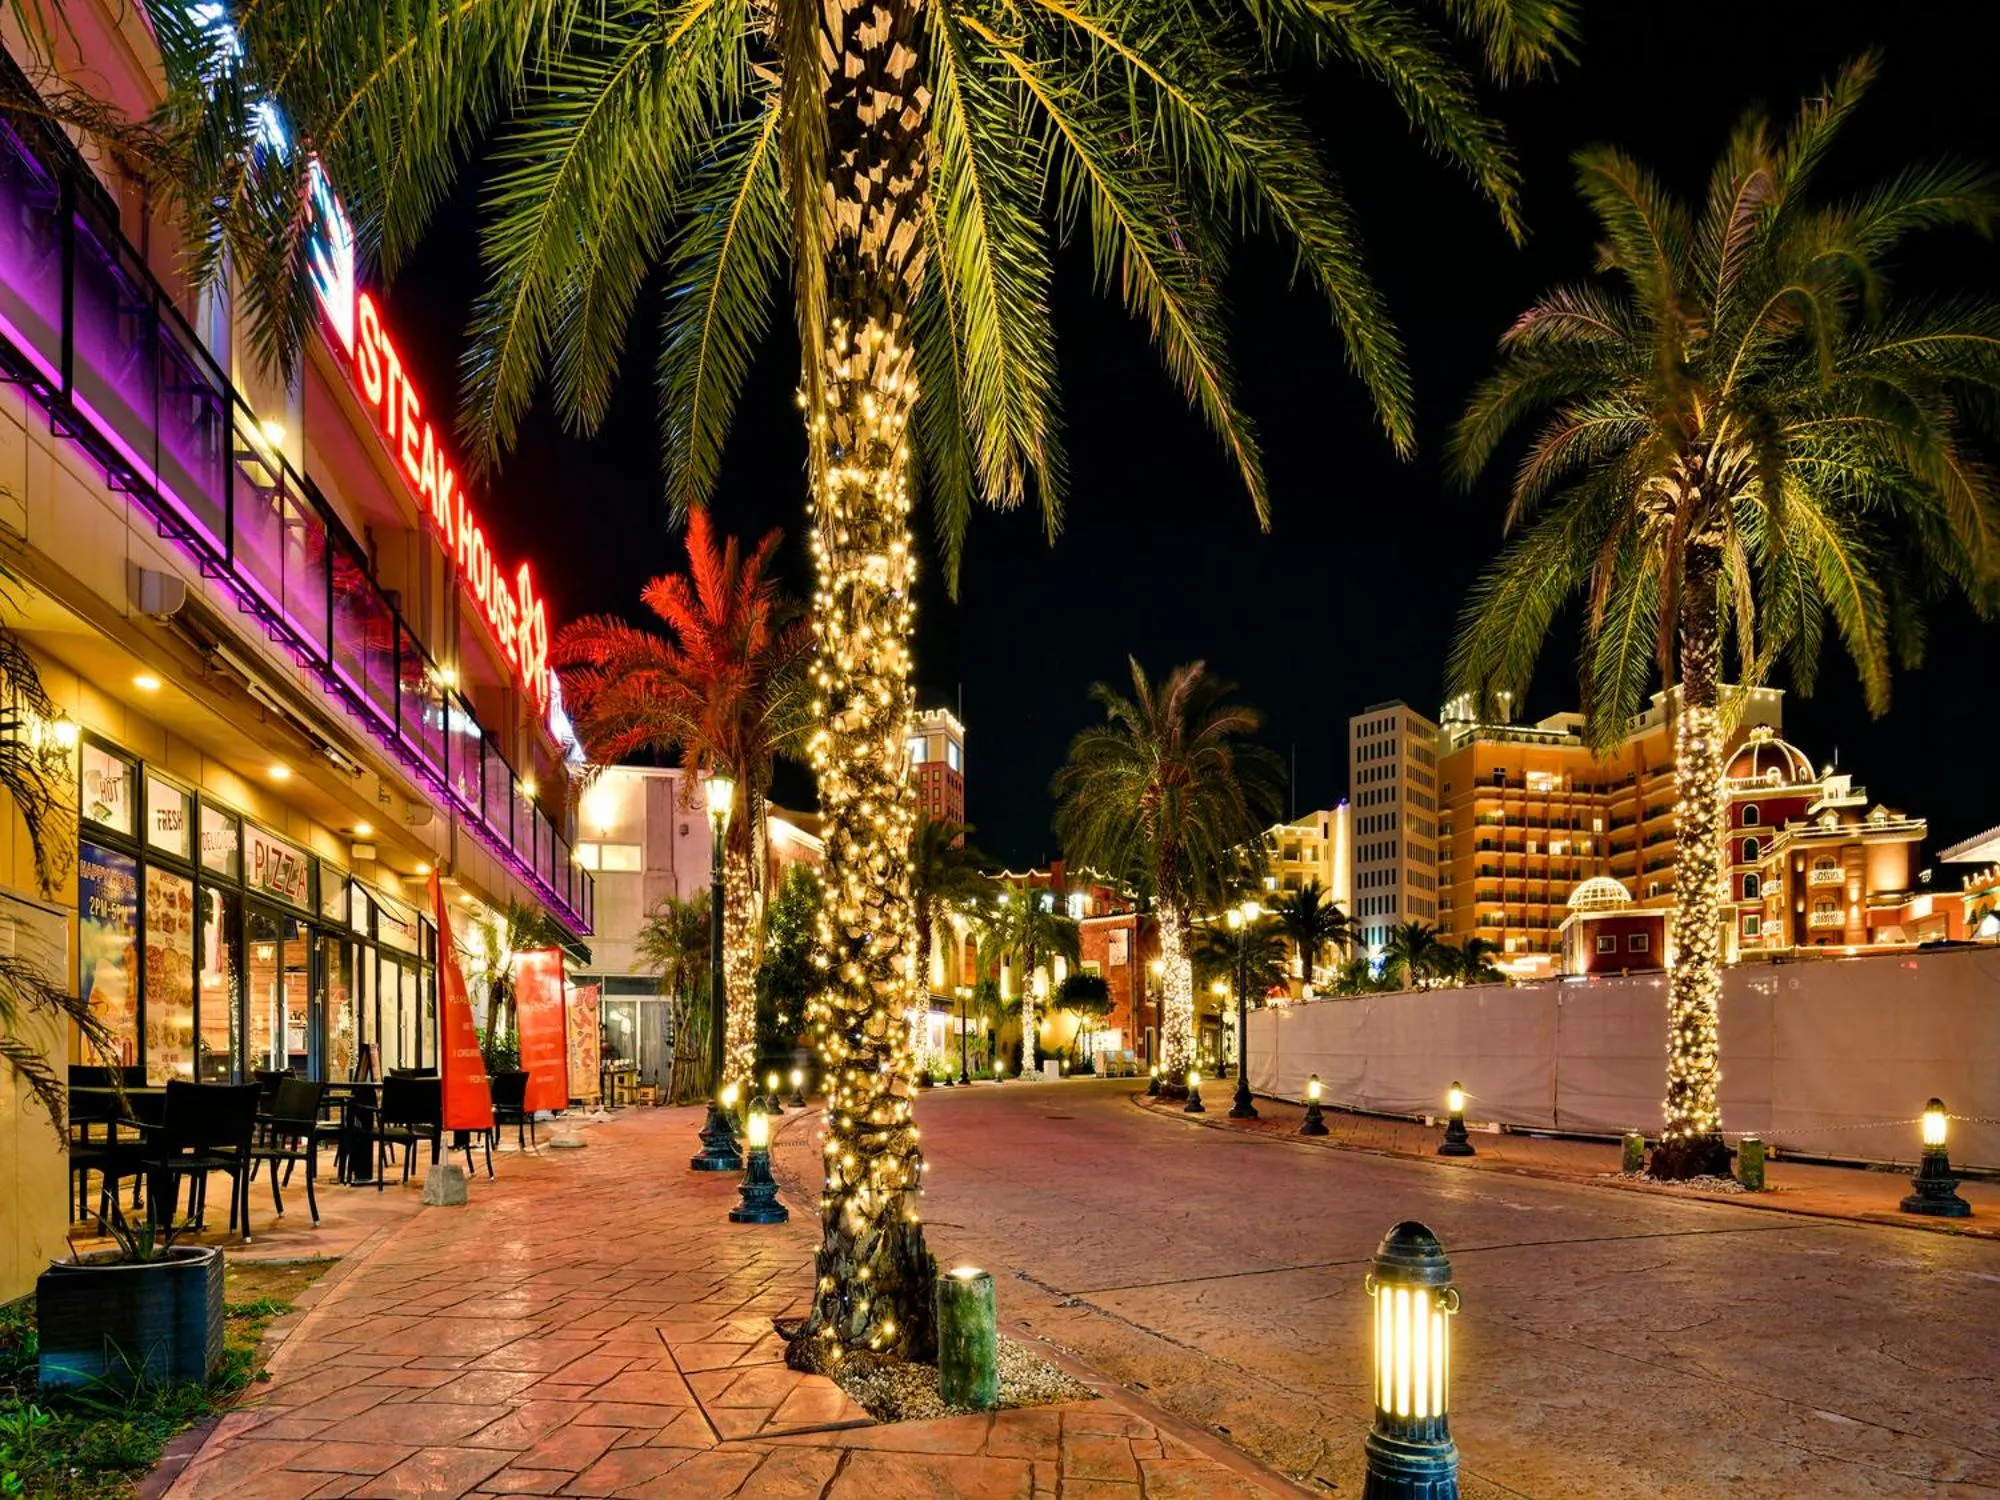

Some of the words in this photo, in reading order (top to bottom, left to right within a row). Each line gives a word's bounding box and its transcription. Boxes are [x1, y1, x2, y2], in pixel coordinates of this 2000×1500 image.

[357, 292, 454, 546] STEAK
[458, 490, 517, 664] HOUSE
[99, 777, 120, 803] HOT
[157, 808, 184, 832] FRESH
[255, 839, 307, 900] PIZZA
